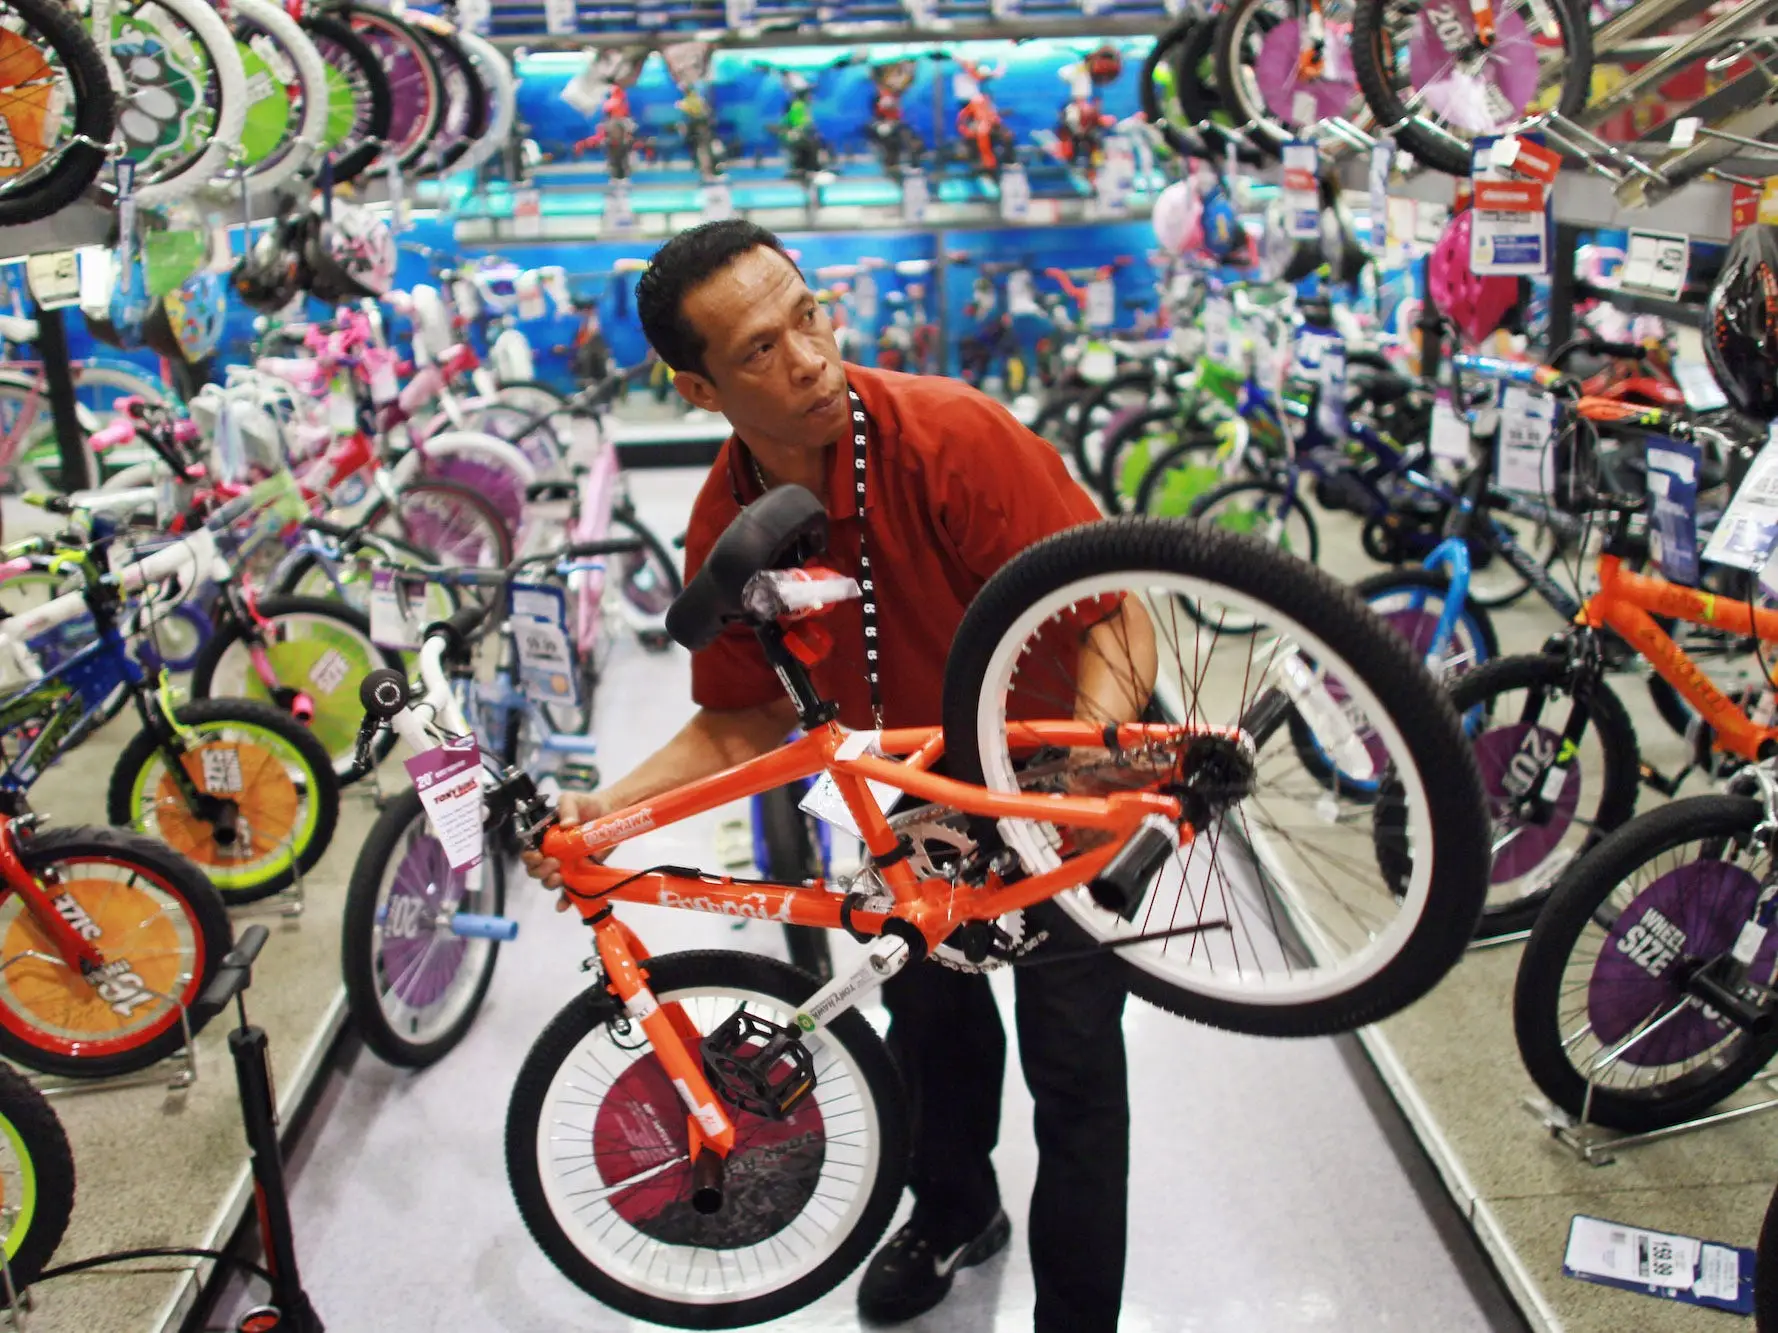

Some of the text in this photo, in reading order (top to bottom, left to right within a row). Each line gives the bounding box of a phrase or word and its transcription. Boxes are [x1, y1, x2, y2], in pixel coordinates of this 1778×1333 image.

[1616, 924, 1677, 979] SIZE
[1639, 907, 1687, 953] WHEEL
[831, 983, 857, 1004] TONY
